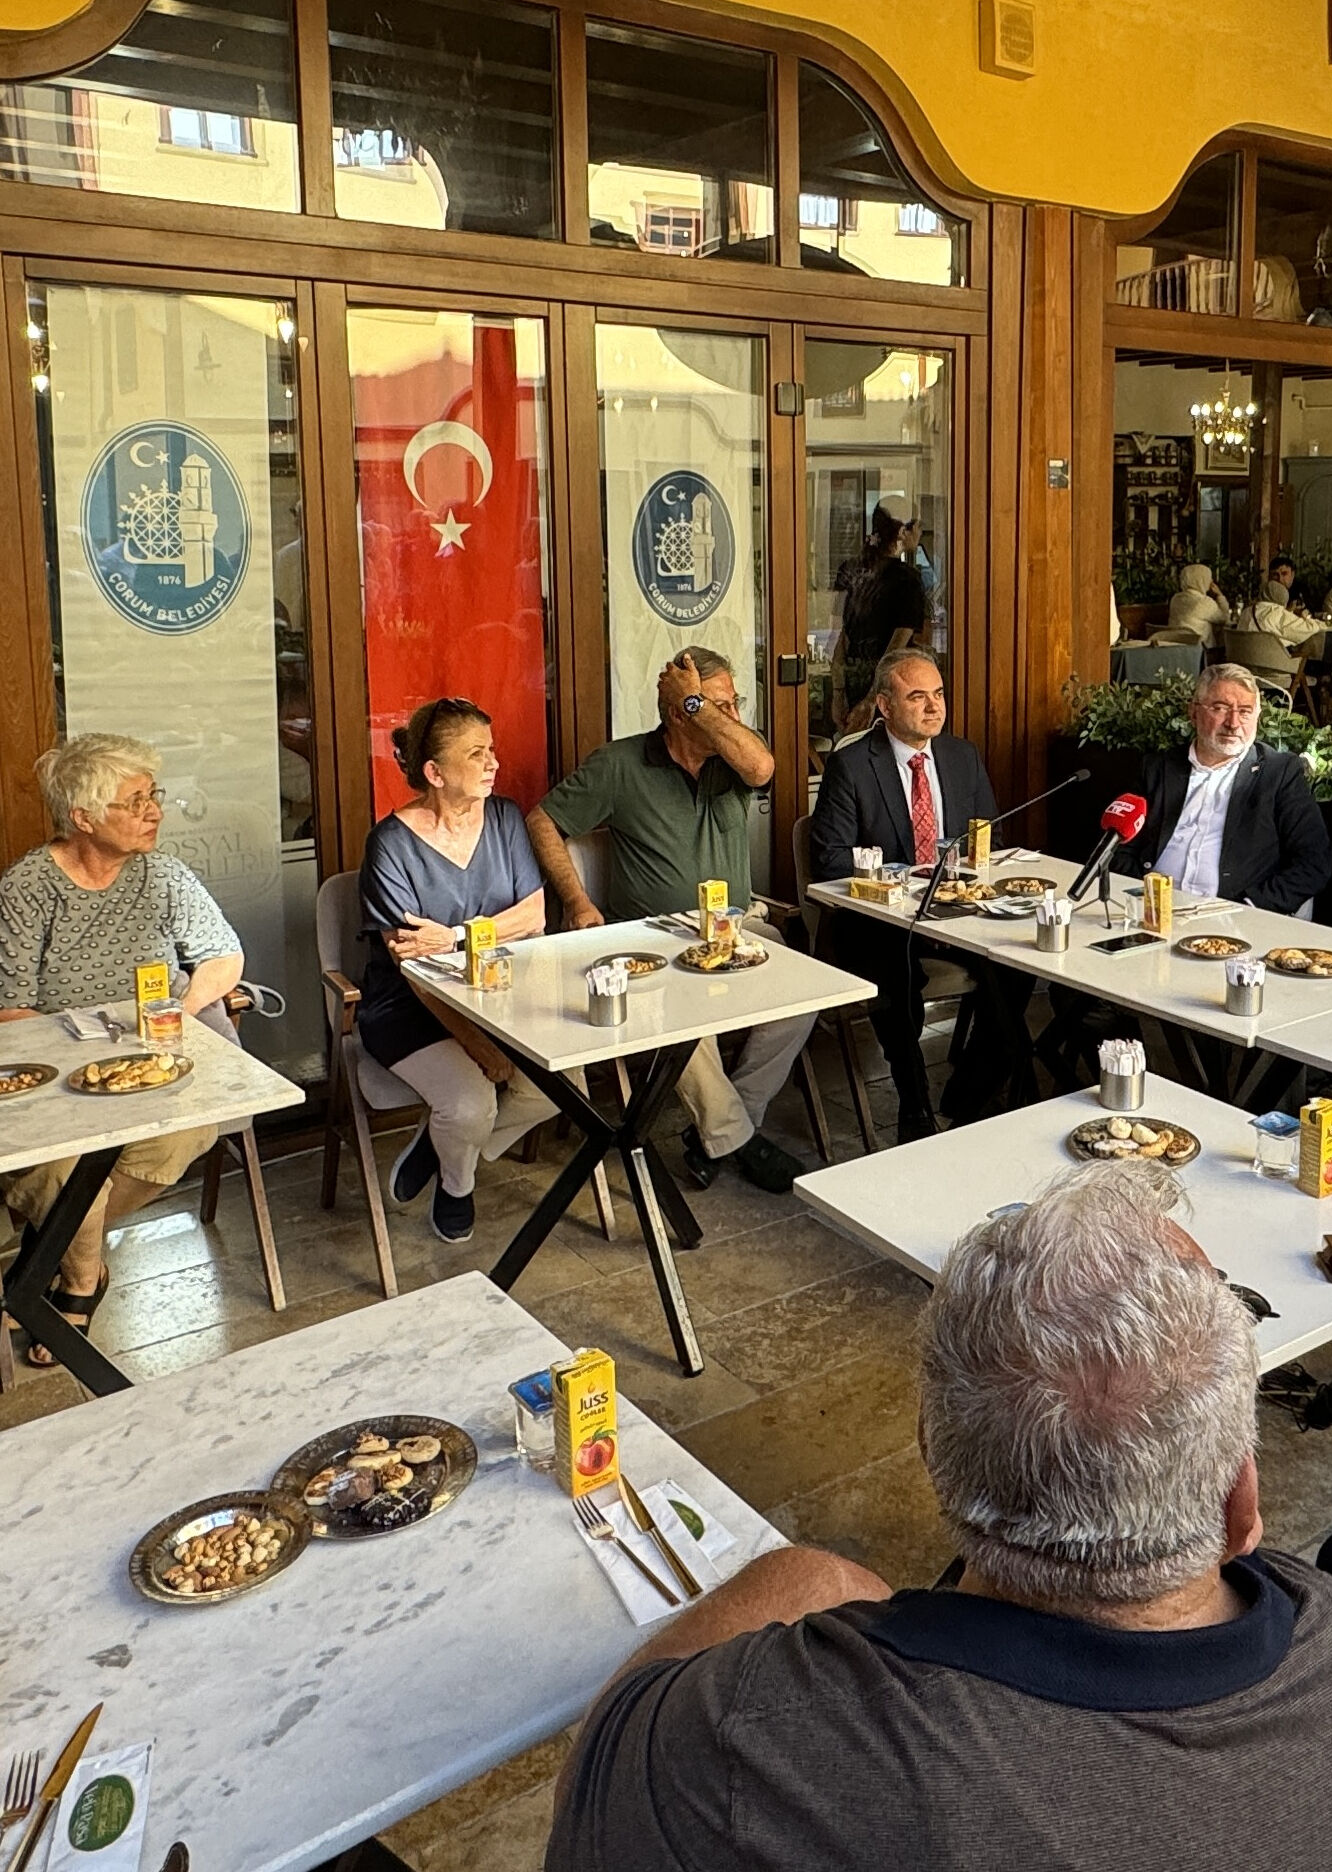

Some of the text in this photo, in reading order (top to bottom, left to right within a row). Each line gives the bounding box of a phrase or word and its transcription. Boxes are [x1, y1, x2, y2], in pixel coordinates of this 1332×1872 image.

[157, 575, 182, 585] 1876
[156, 573, 231, 622] BELEDİYESİ
[577, 1391, 609, 1414] Juss
